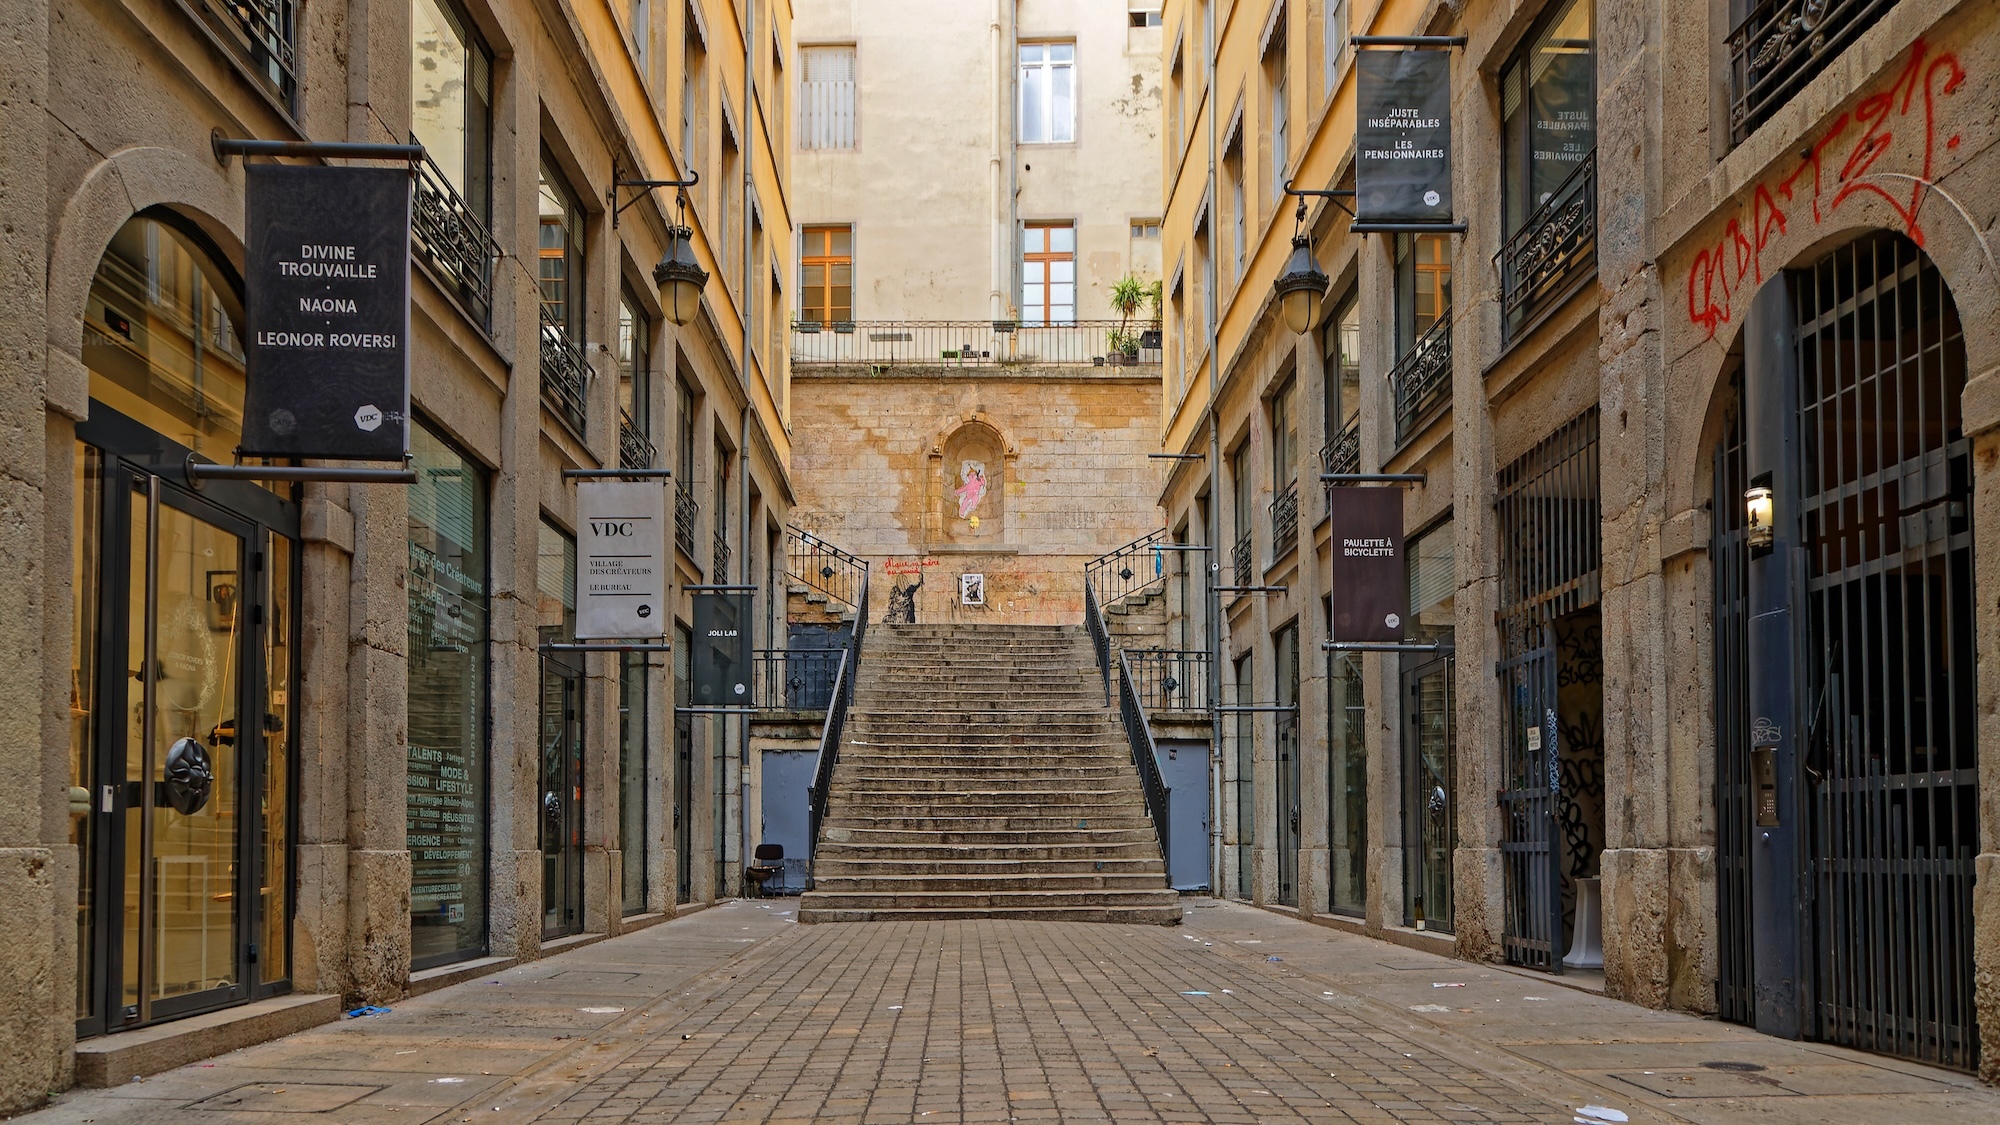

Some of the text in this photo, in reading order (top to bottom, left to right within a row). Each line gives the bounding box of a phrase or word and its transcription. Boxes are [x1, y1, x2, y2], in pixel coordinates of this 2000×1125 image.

[1388, 108, 1419, 118] JUSTE
[1368, 117, 1441, 129] INSÉPARABLES
[1394, 140, 1413, 150] LES
[1364, 149, 1444, 160] PENSIONNAIRES
[301, 244, 356, 260] DIVINE
[279, 261, 377, 279] TROUVAILLE
[299, 297, 358, 313] NAONA
[257, 331, 396, 348] LEONOR ROVERSI
[359, 413, 378, 423] VDC
[1748, 507, 1760, 528] 4
[589, 522, 633, 537] VDC
[1343, 536, 1393, 548] PAULETTE À
[1344, 548, 1394, 557] BICYCLETTE
[409, 541, 429, 567] llage
[430, 553, 446, 573] des
[446, 563, 483, 594] Créateurs
[605, 566, 652, 575] CRÉATEURS
[420, 587, 446, 608] LABEL
[707, 629, 738, 637] JOLI LAB
[454, 640, 469, 654] Lyon
[408, 746, 443, 762] TALENTS
[440, 766, 463, 780] MODE
[463, 769, 470, 781] &
[407, 775, 474, 795] SSION LIFESTYLE
[416, 794, 443, 806] Auvergne
[443, 796, 475, 810] Rhône-Alpes
[442, 810, 475, 824] RÉUSSITES
[407, 835, 441, 847] ERGENCE
[423, 849, 473, 859] DÉVELOPPEMENT
[411, 884, 462, 895] AVENTURECREATEUR
